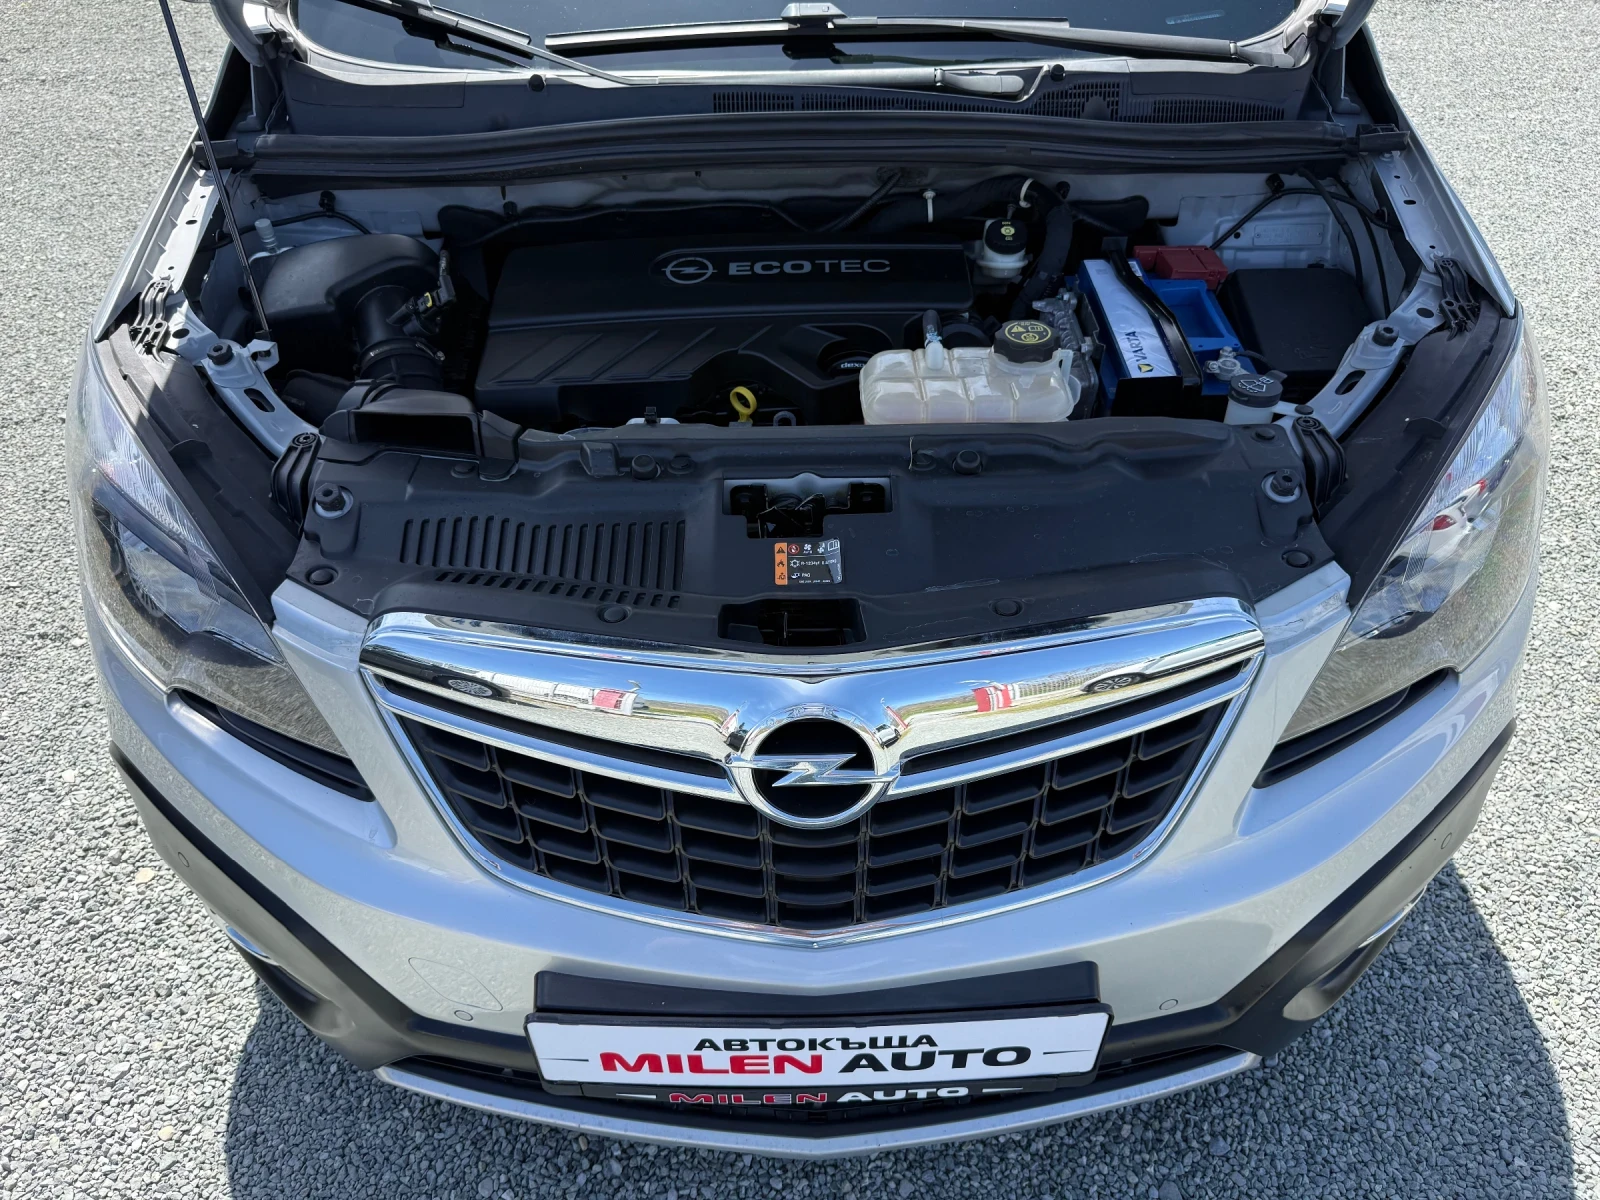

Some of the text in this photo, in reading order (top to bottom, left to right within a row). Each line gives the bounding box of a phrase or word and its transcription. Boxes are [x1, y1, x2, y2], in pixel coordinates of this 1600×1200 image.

[728, 259, 891, 276] ECOTEC
[1124, 330, 1148, 363] VARTA
[599, 1046, 1032, 1074] MILEN AUTO
[669, 1086, 969, 1105] MILEN AUTO
